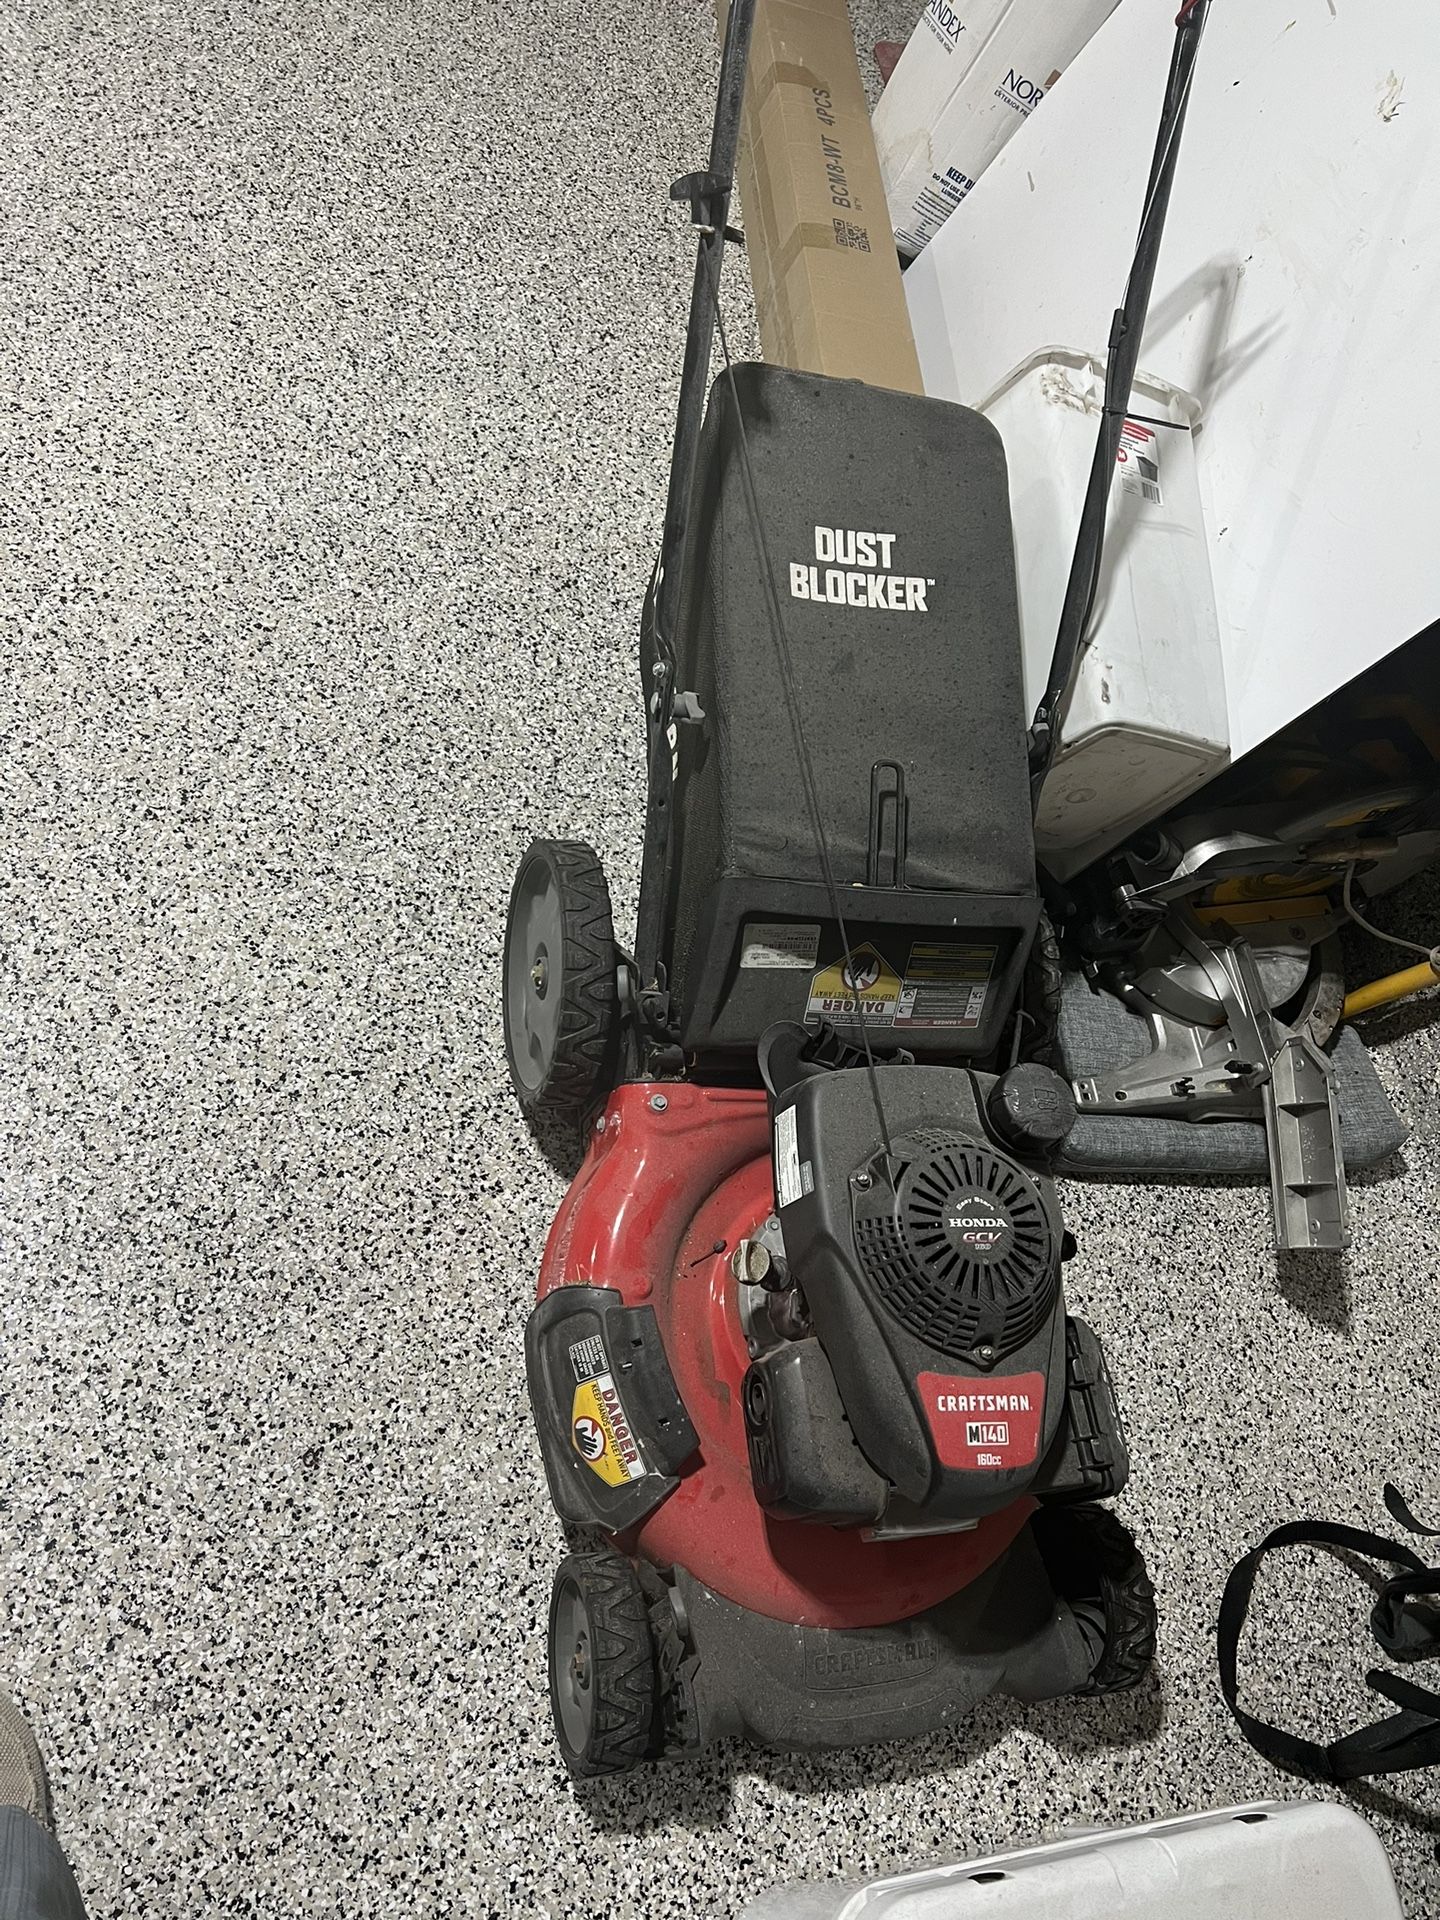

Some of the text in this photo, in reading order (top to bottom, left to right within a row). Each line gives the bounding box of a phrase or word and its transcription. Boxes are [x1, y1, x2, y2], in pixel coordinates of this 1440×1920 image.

[994, 89, 1021, 113] EXTERIOR
[812, 87, 851, 209] BCM8-WT 4PCS
[946, 167, 968, 185] KEEP
[814, 525, 896, 569] DUST
[948, 1218, 1008, 1228] HONDA
[962, 1232, 1002, 1243] GCV
[937, 1395, 1031, 1411] CRAFTSMAN
[590, 1384, 630, 1478] KEEP HANDS and FEET AWAY
[601, 1388, 638, 1465] DANGER
[968, 1425, 1006, 1443] M140
[977, 1453, 1002, 1466] 160cc
